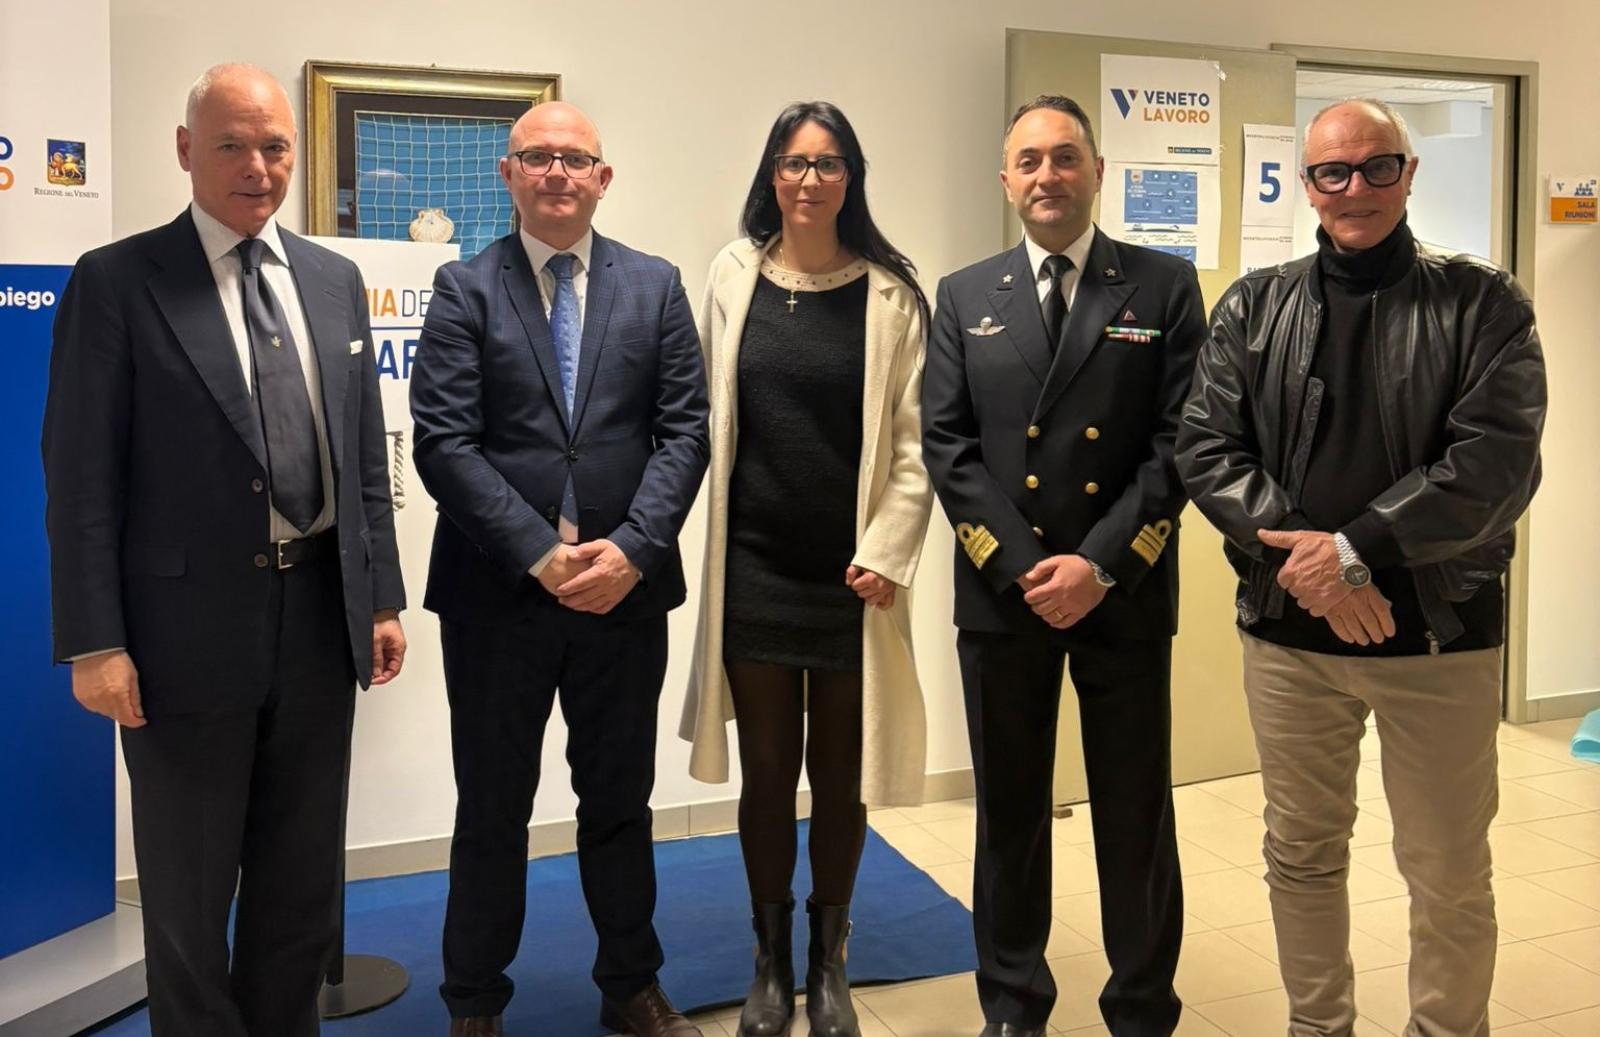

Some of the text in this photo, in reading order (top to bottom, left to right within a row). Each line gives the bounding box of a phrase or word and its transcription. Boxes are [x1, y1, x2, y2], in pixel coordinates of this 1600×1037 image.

[1144, 90, 1210, 107] VENETO
[1144, 107, 1210, 124] LAVORO
[1259, 161, 1281, 204] 5
